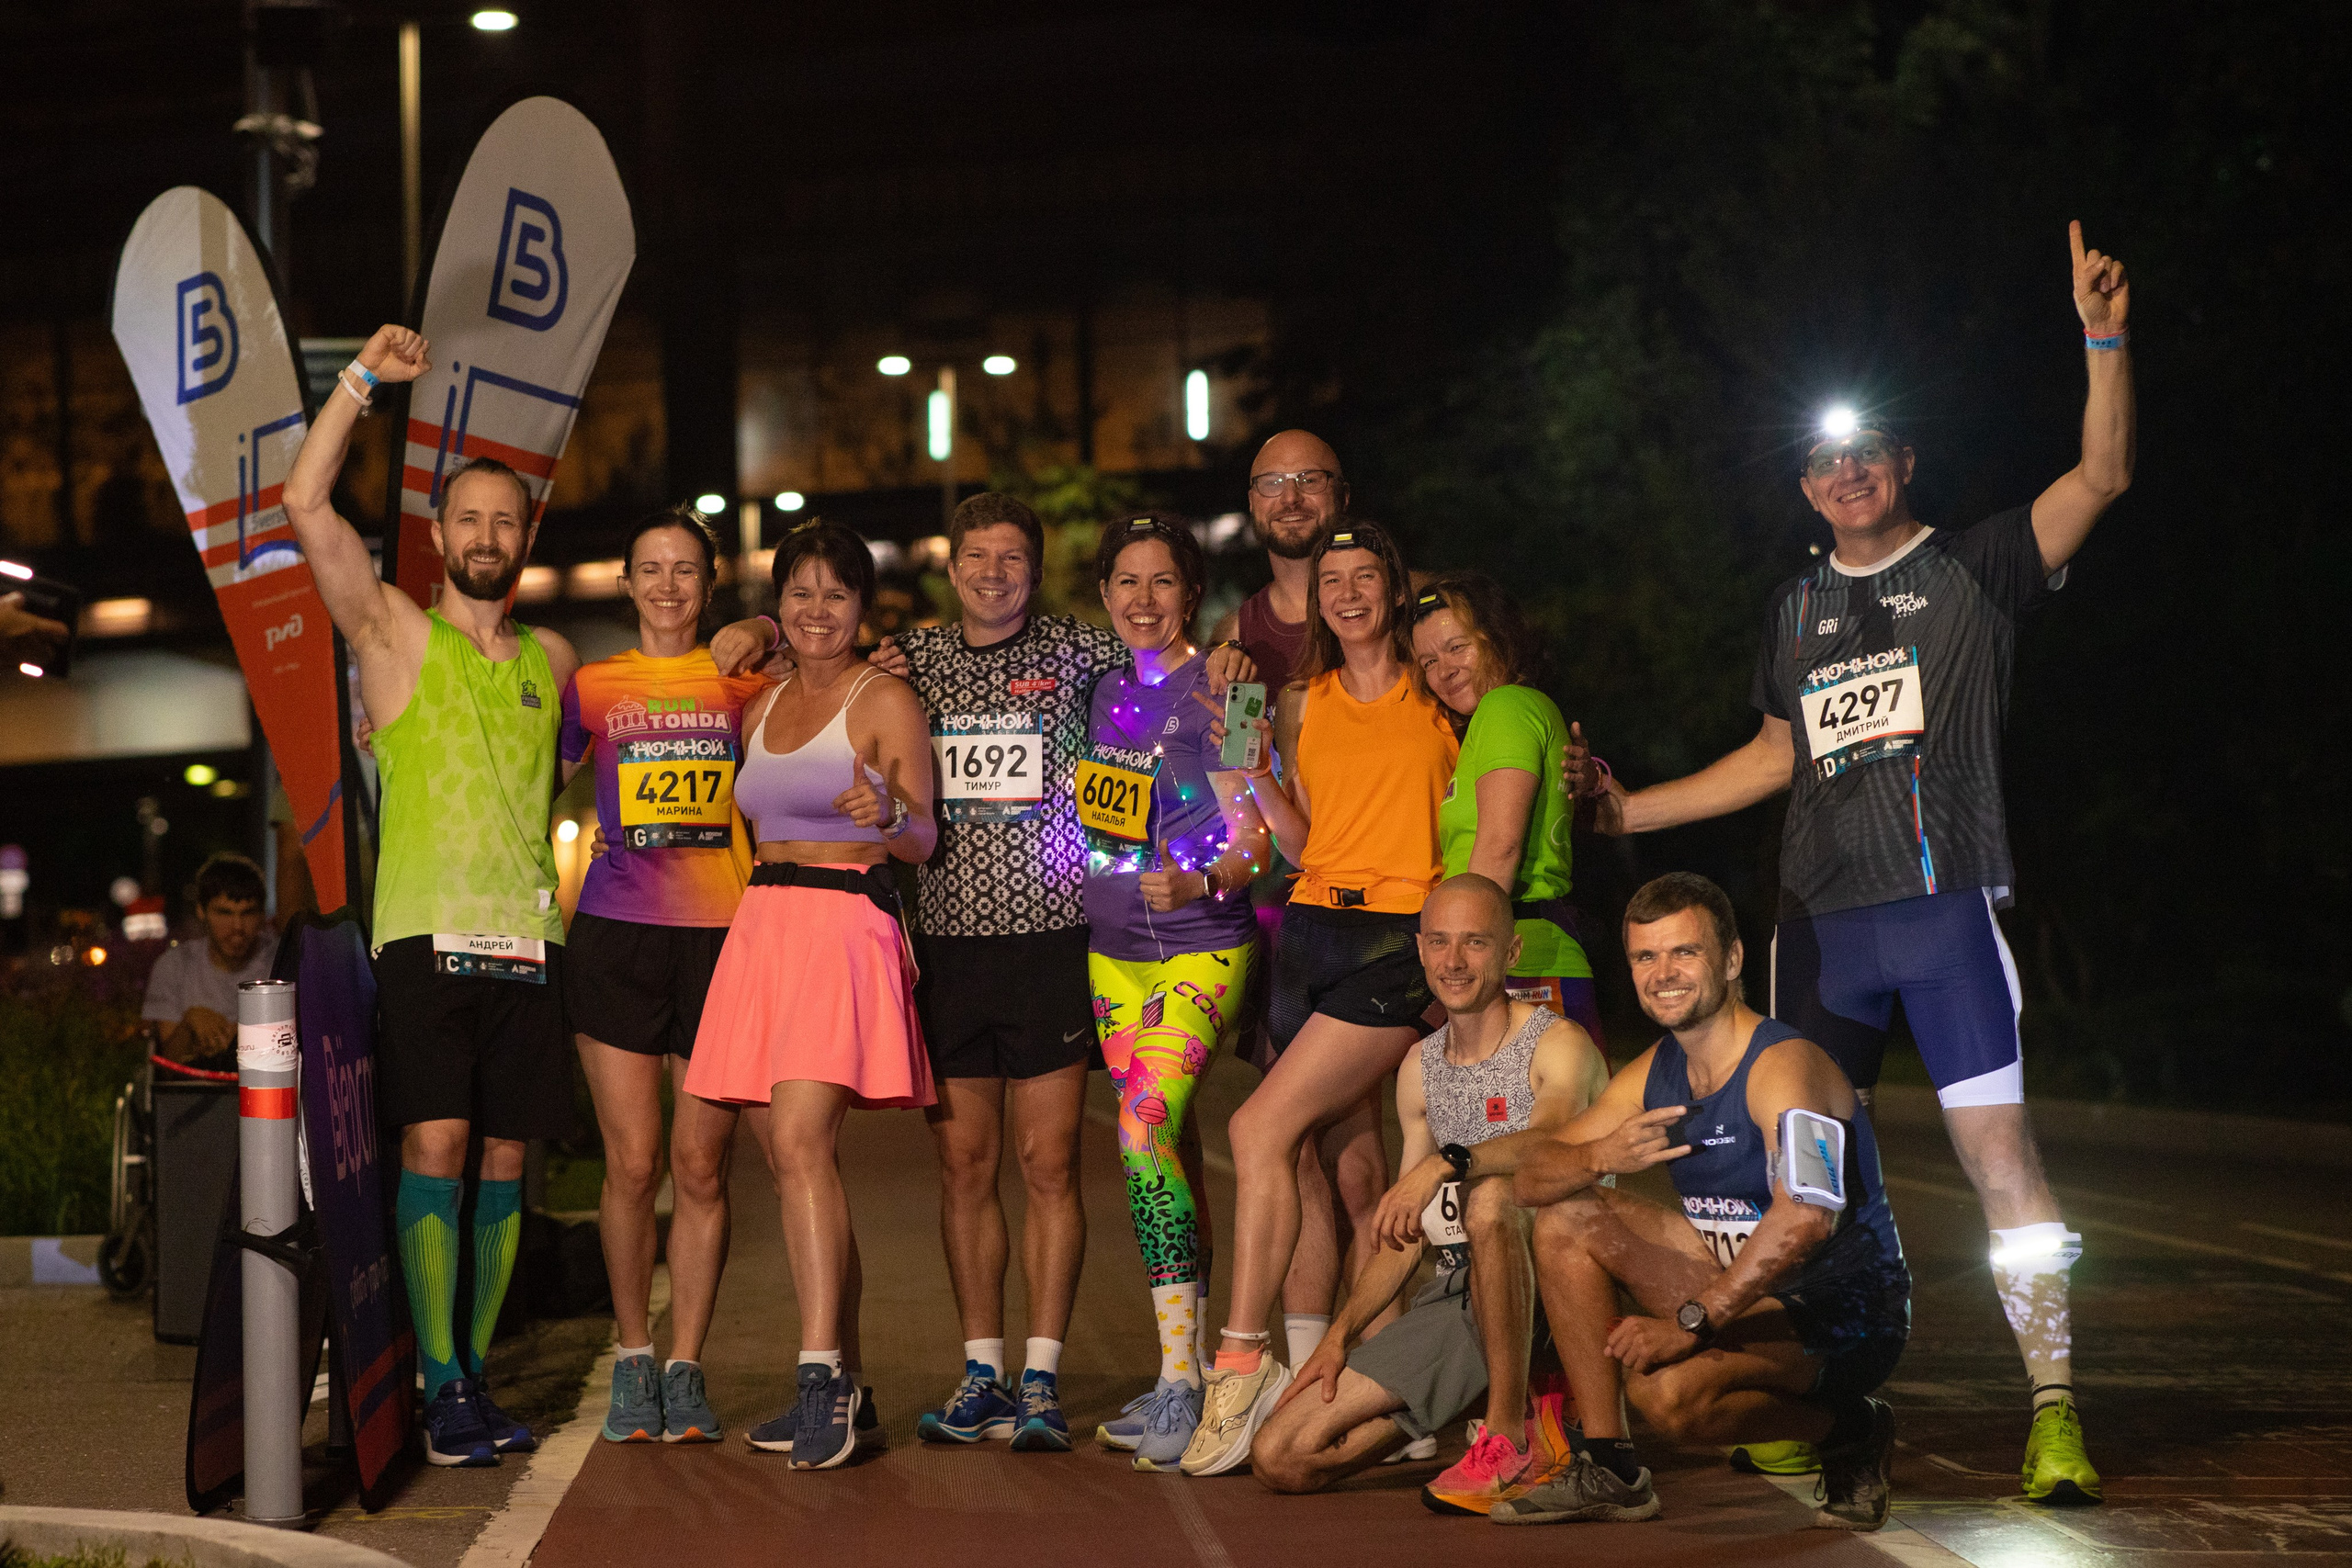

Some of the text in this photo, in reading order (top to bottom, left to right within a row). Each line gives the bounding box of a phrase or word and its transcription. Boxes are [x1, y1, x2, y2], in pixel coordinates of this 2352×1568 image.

[1817, 617, 1838, 636] GRi
[647, 697, 696, 714] RUN
[1819, 678, 1904, 729] 4297
[648, 712, 729, 729] TONDA
[1837, 716, 1889, 743] ДМИТРИЙ
[945, 744, 1027, 778] 1692
[1823, 757, 1836, 778] D
[636, 771, 722, 804] 4217
[965, 782, 1001, 791] ТИМУР
[1082, 773, 1139, 817] 6021
[657, 807, 703, 816] МАРИНА
[1091, 810, 1125, 827] НАТАЛЬЯ
[634, 829, 647, 847] G
[469, 940, 514, 950] АНДРЕЙ
[446, 955, 459, 972] C
[1532, 989, 1549, 999] RUN
[1442, 1248, 1456, 1267] B
